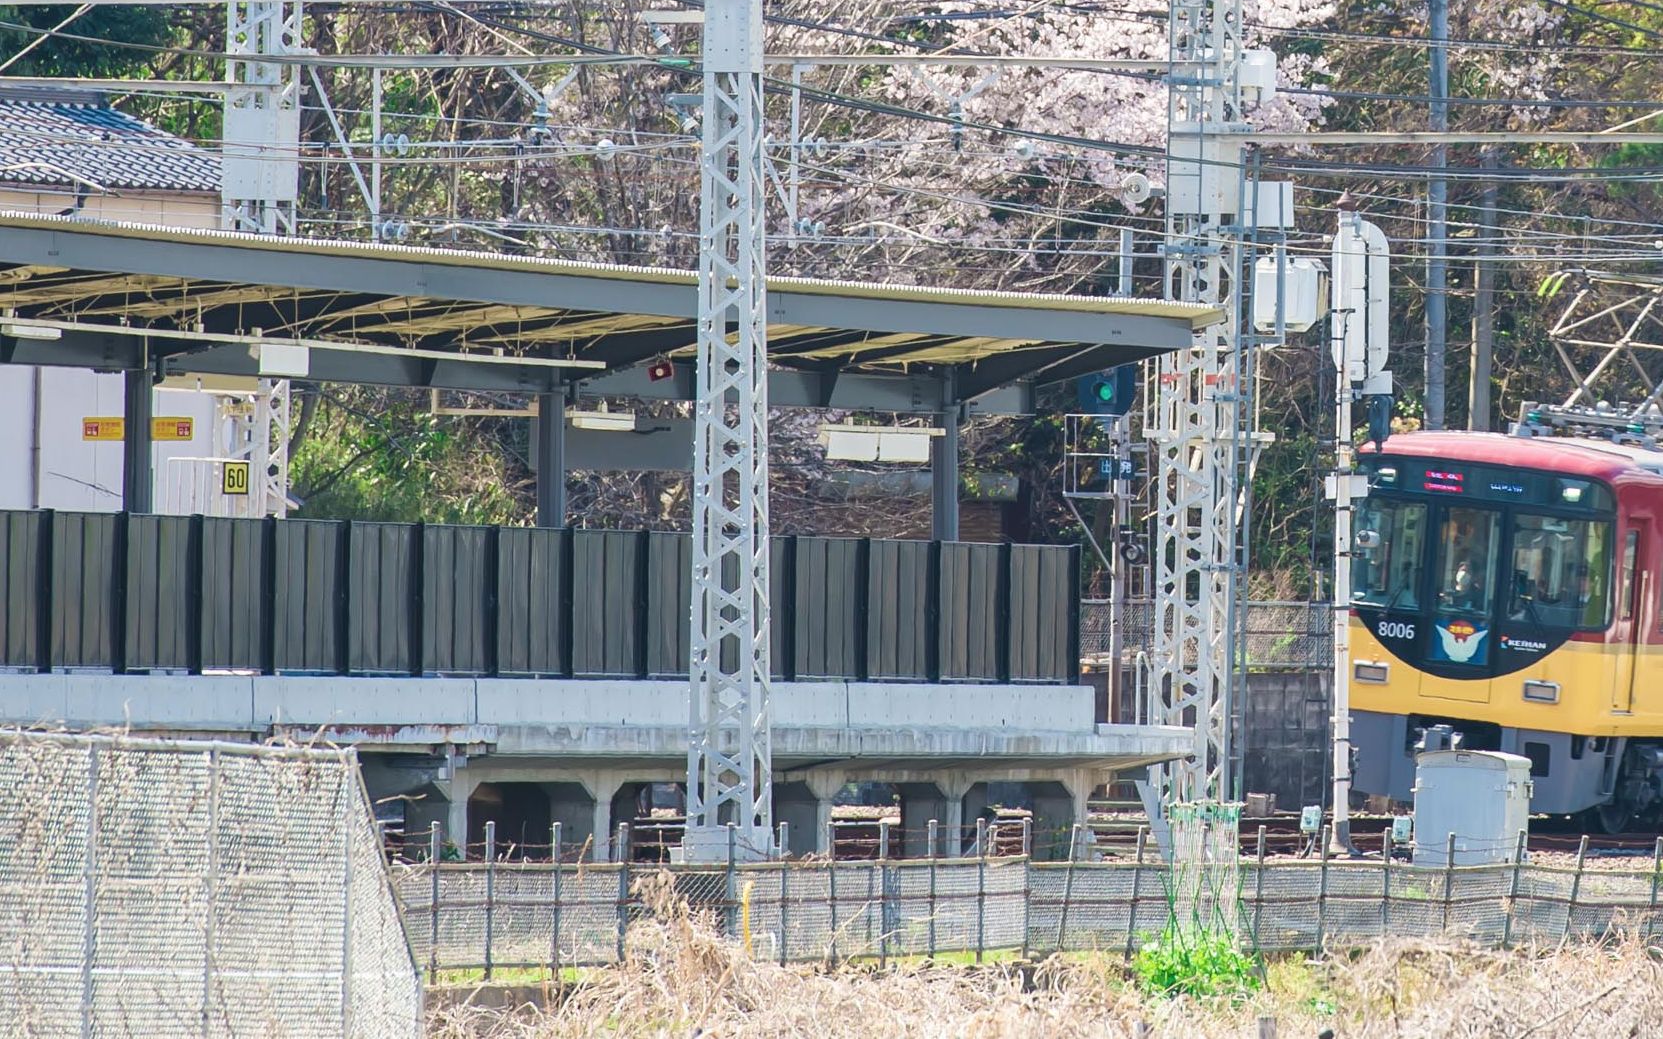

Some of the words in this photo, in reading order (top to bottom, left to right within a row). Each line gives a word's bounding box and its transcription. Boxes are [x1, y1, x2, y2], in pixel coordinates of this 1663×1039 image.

[227, 468, 245, 488] 60
[1378, 621, 1415, 640] 8006
[1508, 640, 1547, 649] KEIHAN
